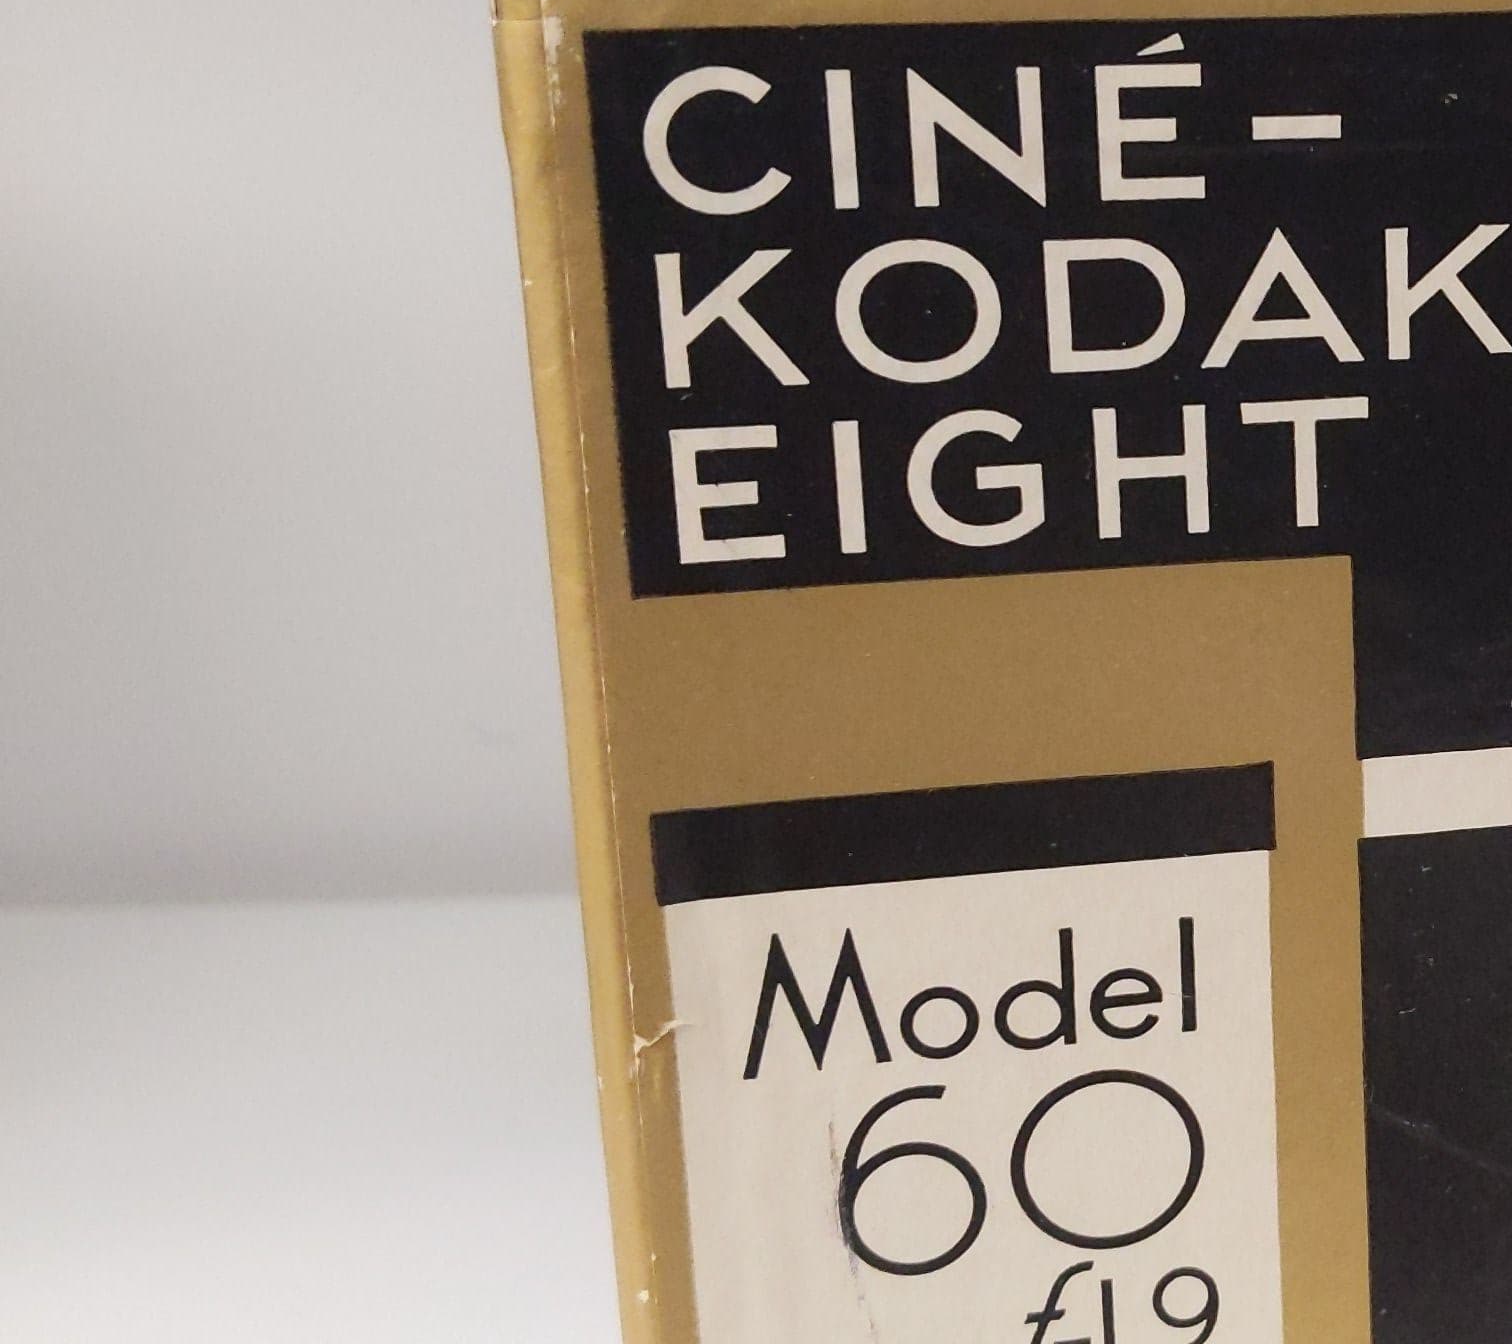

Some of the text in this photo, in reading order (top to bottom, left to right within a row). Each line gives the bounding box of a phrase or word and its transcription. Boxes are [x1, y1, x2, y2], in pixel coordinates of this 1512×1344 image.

[668, 396, 1369, 565] EIGHT
[743, 917, 1197, 1080] Model
[837, 1069, 1205, 1276] 60
